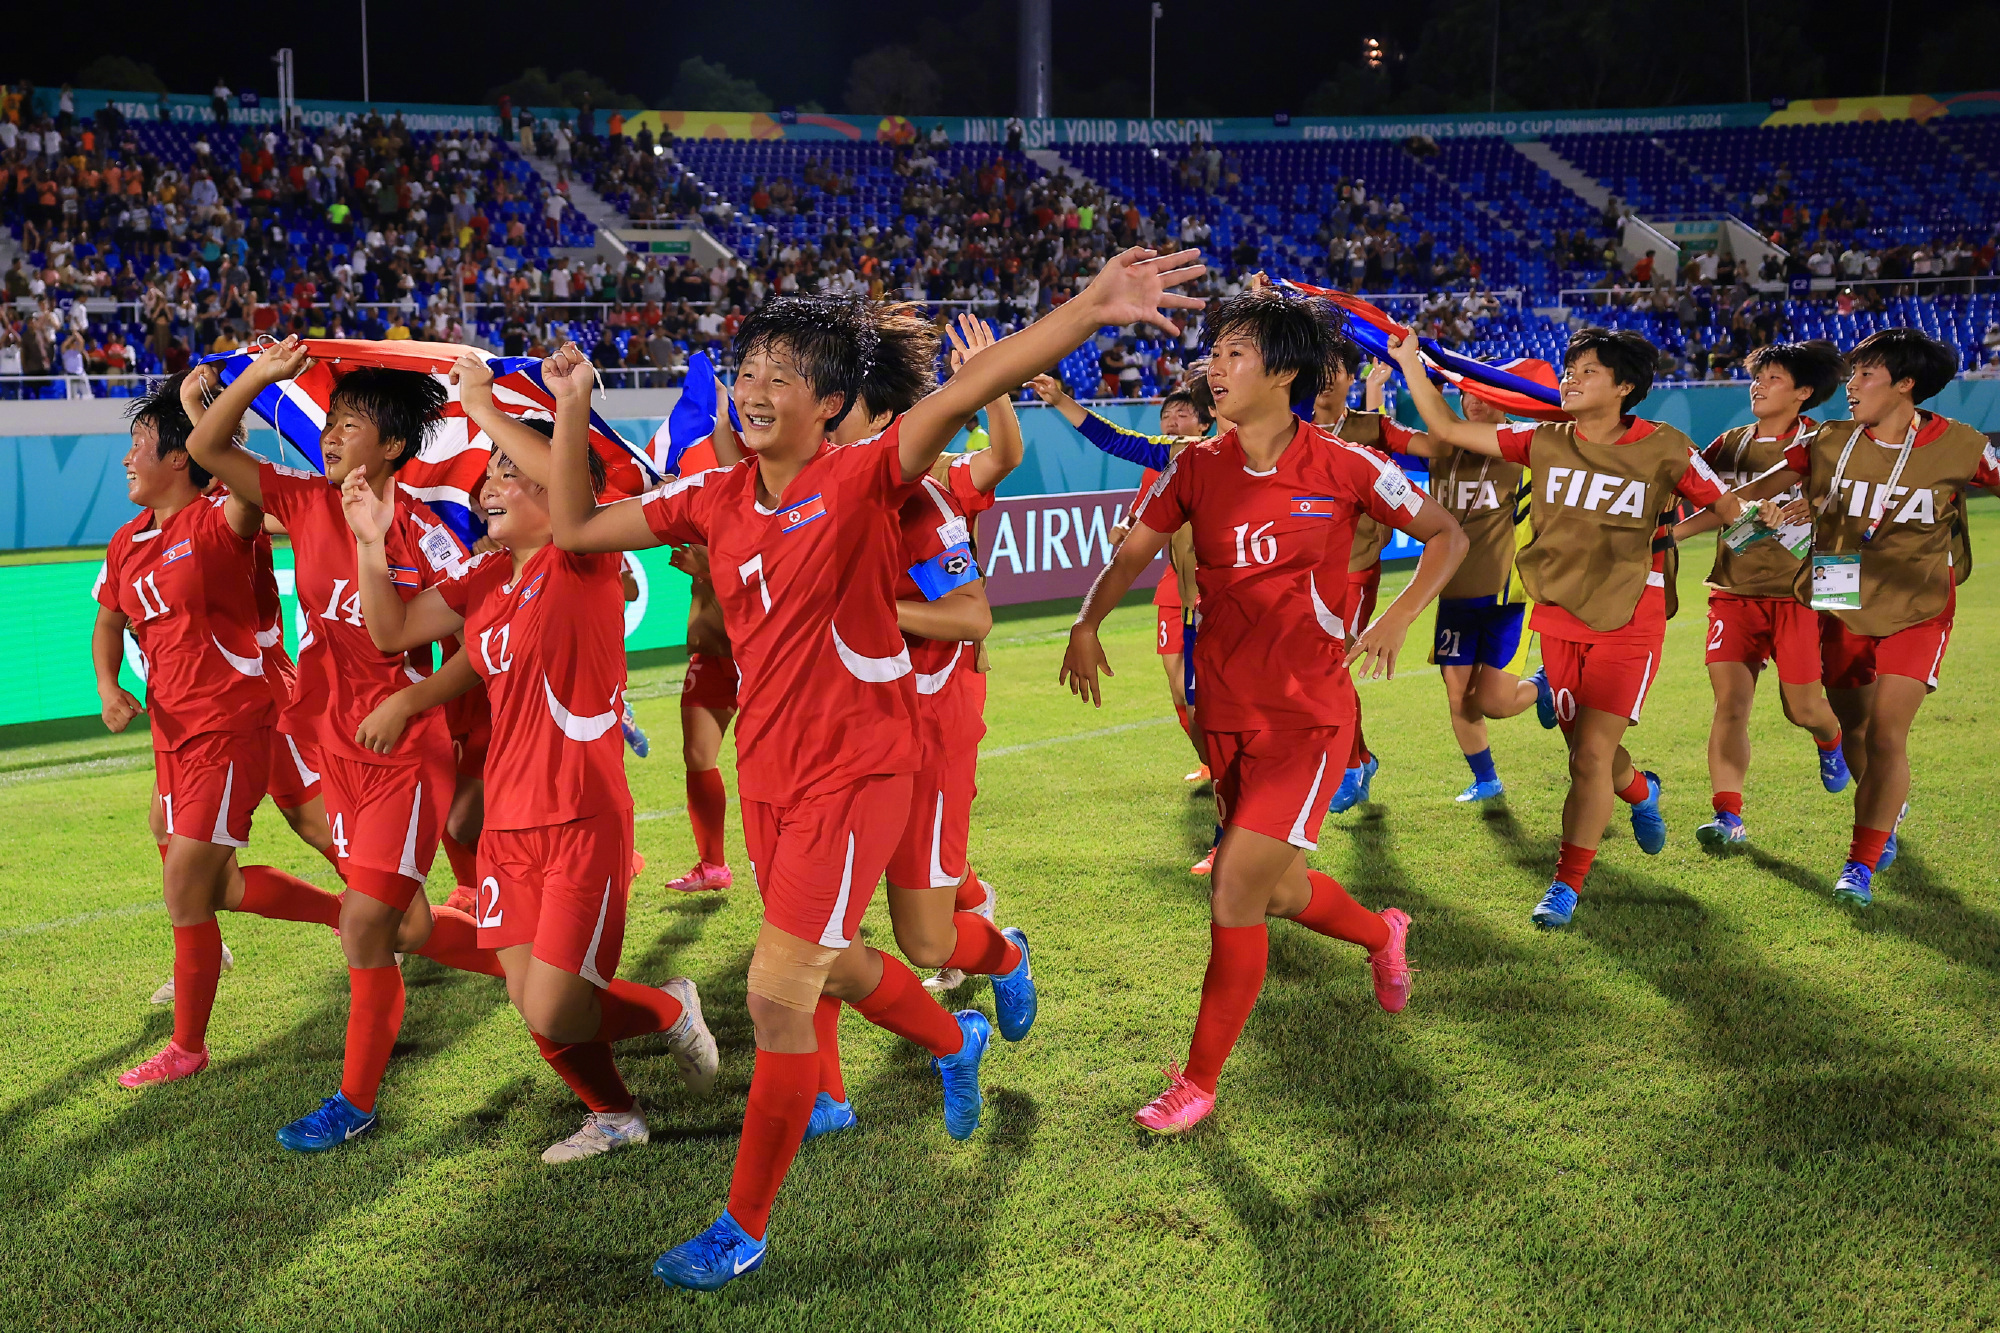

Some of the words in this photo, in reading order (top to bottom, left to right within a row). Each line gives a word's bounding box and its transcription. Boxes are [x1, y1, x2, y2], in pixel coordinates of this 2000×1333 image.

[1063, 119, 1117, 148] YOUR
[1303, 125, 1338, 139] FIFA
[1342, 124, 1375, 138] U-17
[1378, 122, 1454, 139] WOMEN'S
[1458, 120, 1517, 136] WORLD
[1520, 119, 1553, 134] CUP
[1555, 117, 1623, 132] DOMINICAN
[1625, 115, 1686, 130] REPUBLIC
[1689, 113, 1722, 128] 2024
[1545, 466, 1647, 518] FIFA
[986, 503, 1163, 577] AIRW
[1232, 520, 1278, 568] 16
[132, 570, 170, 621] 11
[320, 578, 364, 628] 14
[738, 553, 772, 615] 7
[479, 622, 514, 676] 12
[1437, 628, 1461, 657] 21
[1707, 619, 1724, 651] 2
[326, 812, 350, 858] 4
